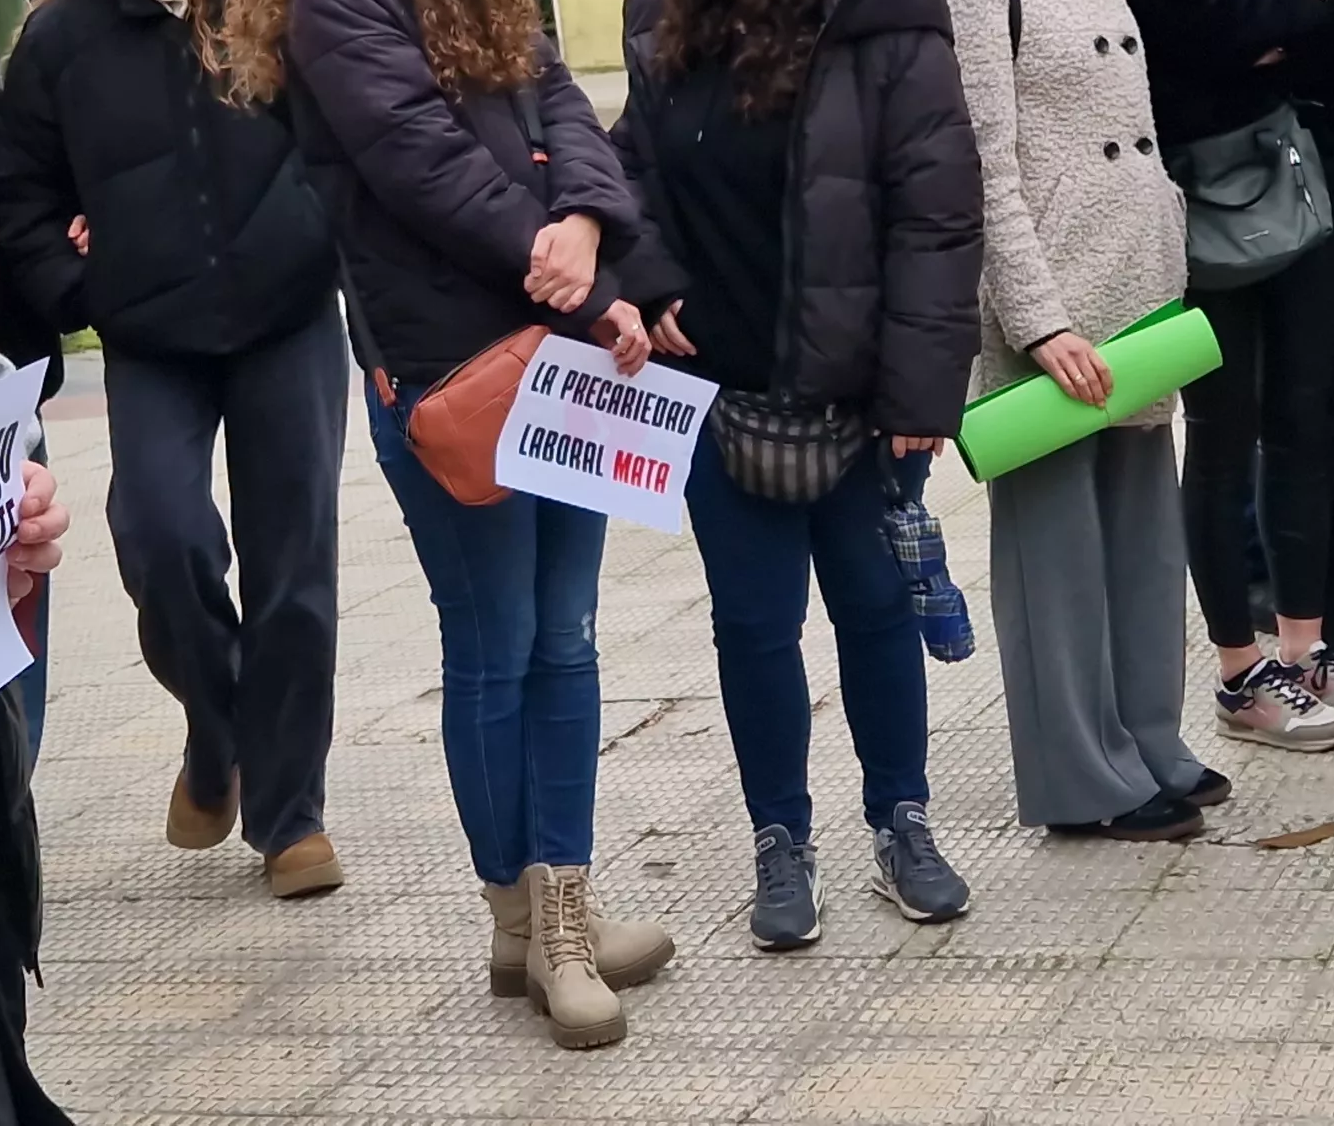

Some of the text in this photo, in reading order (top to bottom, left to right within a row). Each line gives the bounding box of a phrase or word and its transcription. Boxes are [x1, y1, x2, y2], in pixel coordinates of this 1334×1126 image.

[530, 361, 697, 436] LA PRECARIEDAD
[518, 423, 671, 494] LABORAL MATA
